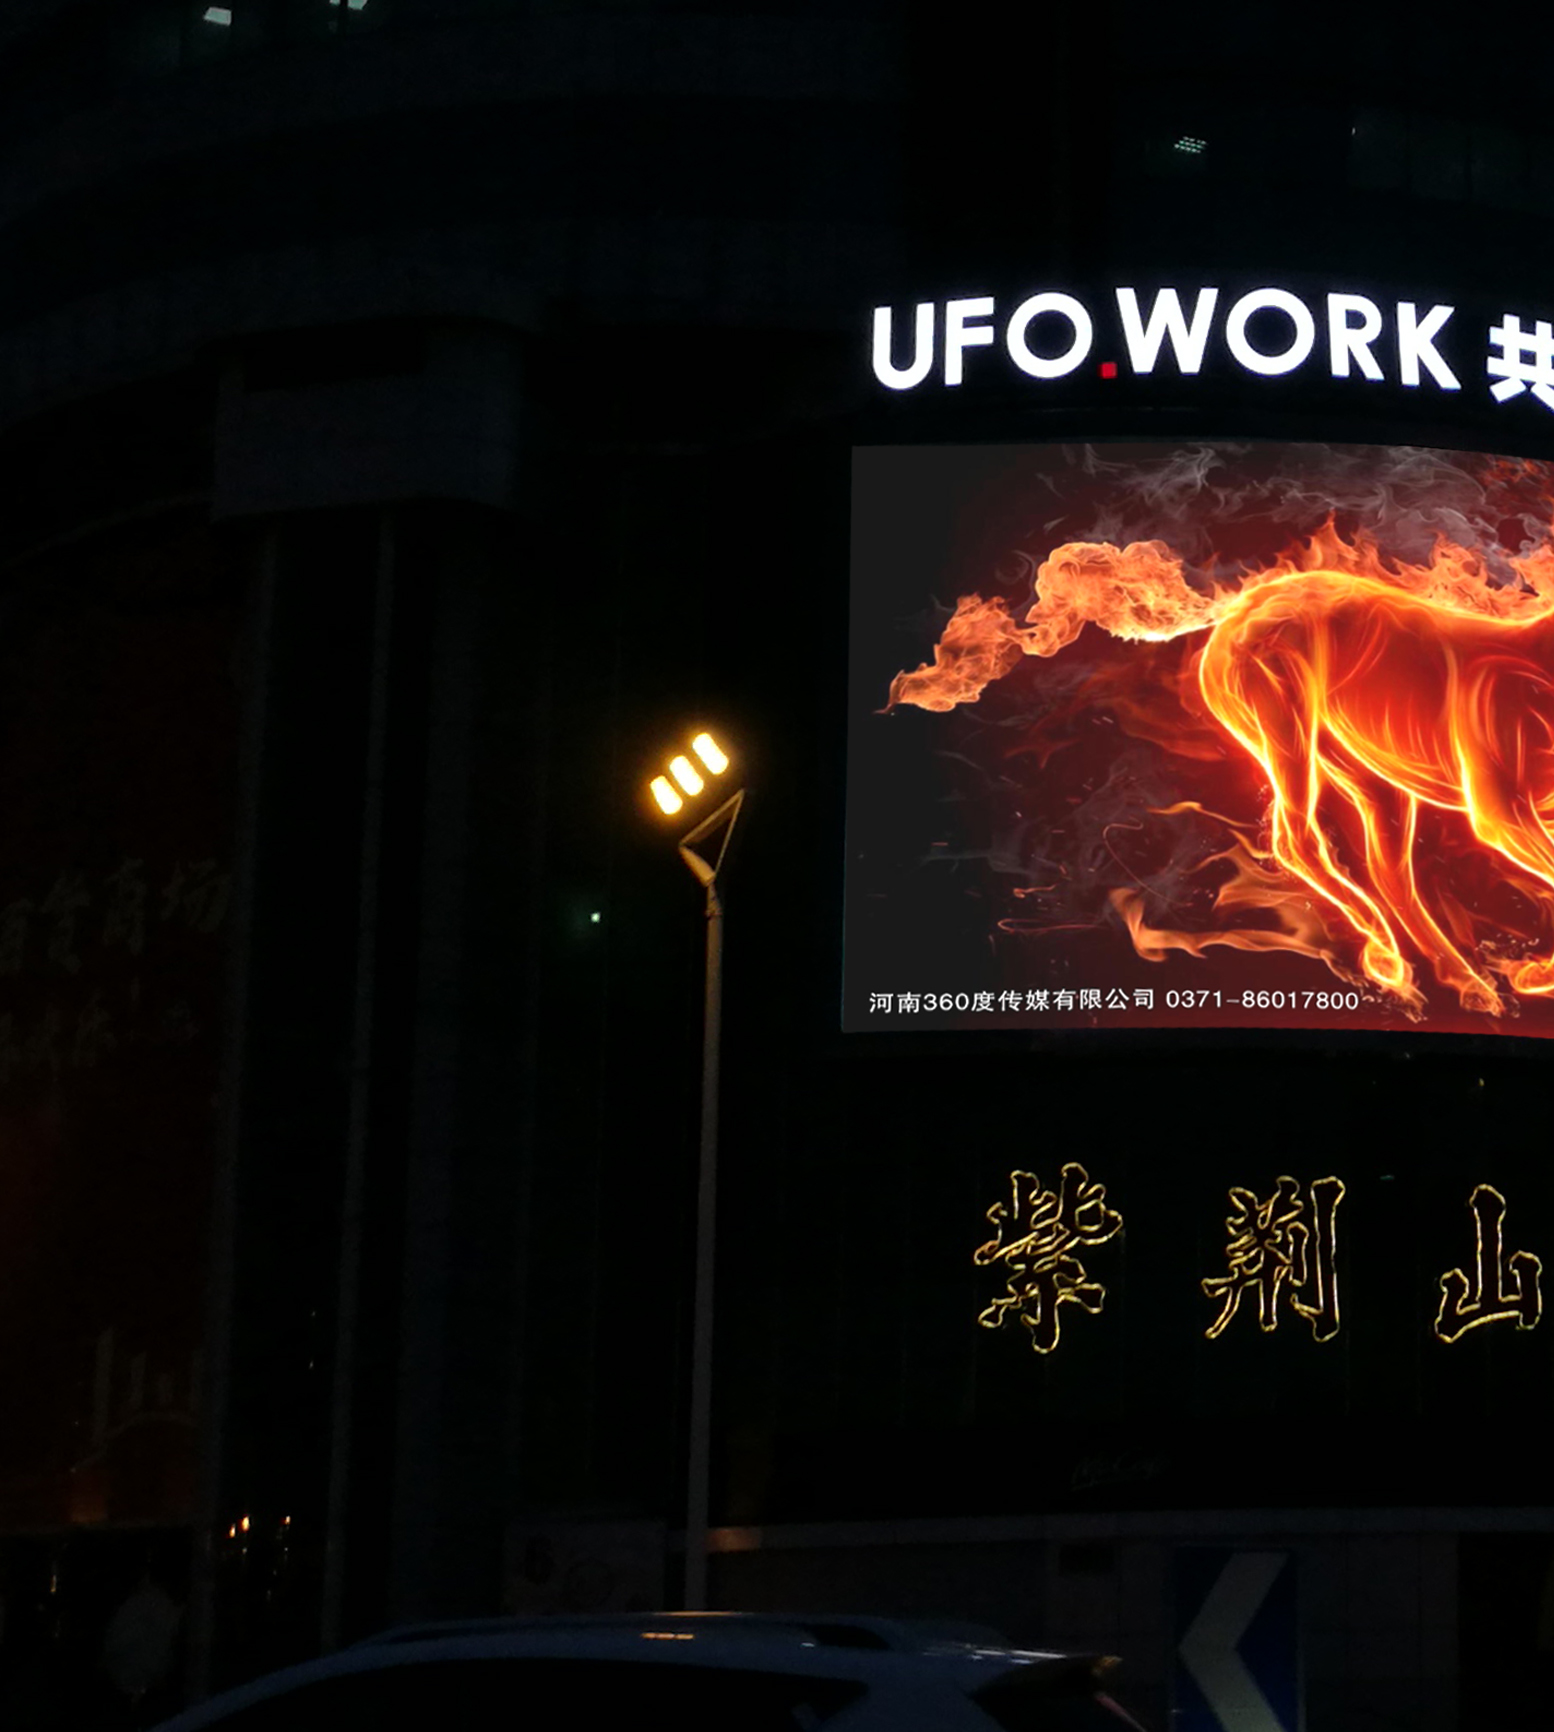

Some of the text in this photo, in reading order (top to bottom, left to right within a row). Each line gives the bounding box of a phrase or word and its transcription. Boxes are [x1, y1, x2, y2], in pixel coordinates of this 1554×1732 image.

[873, 288, 1461, 390] UFO.WORK
[870, 988, 1359, 1014] 河南360度传媒有限公司 0371-86017800
